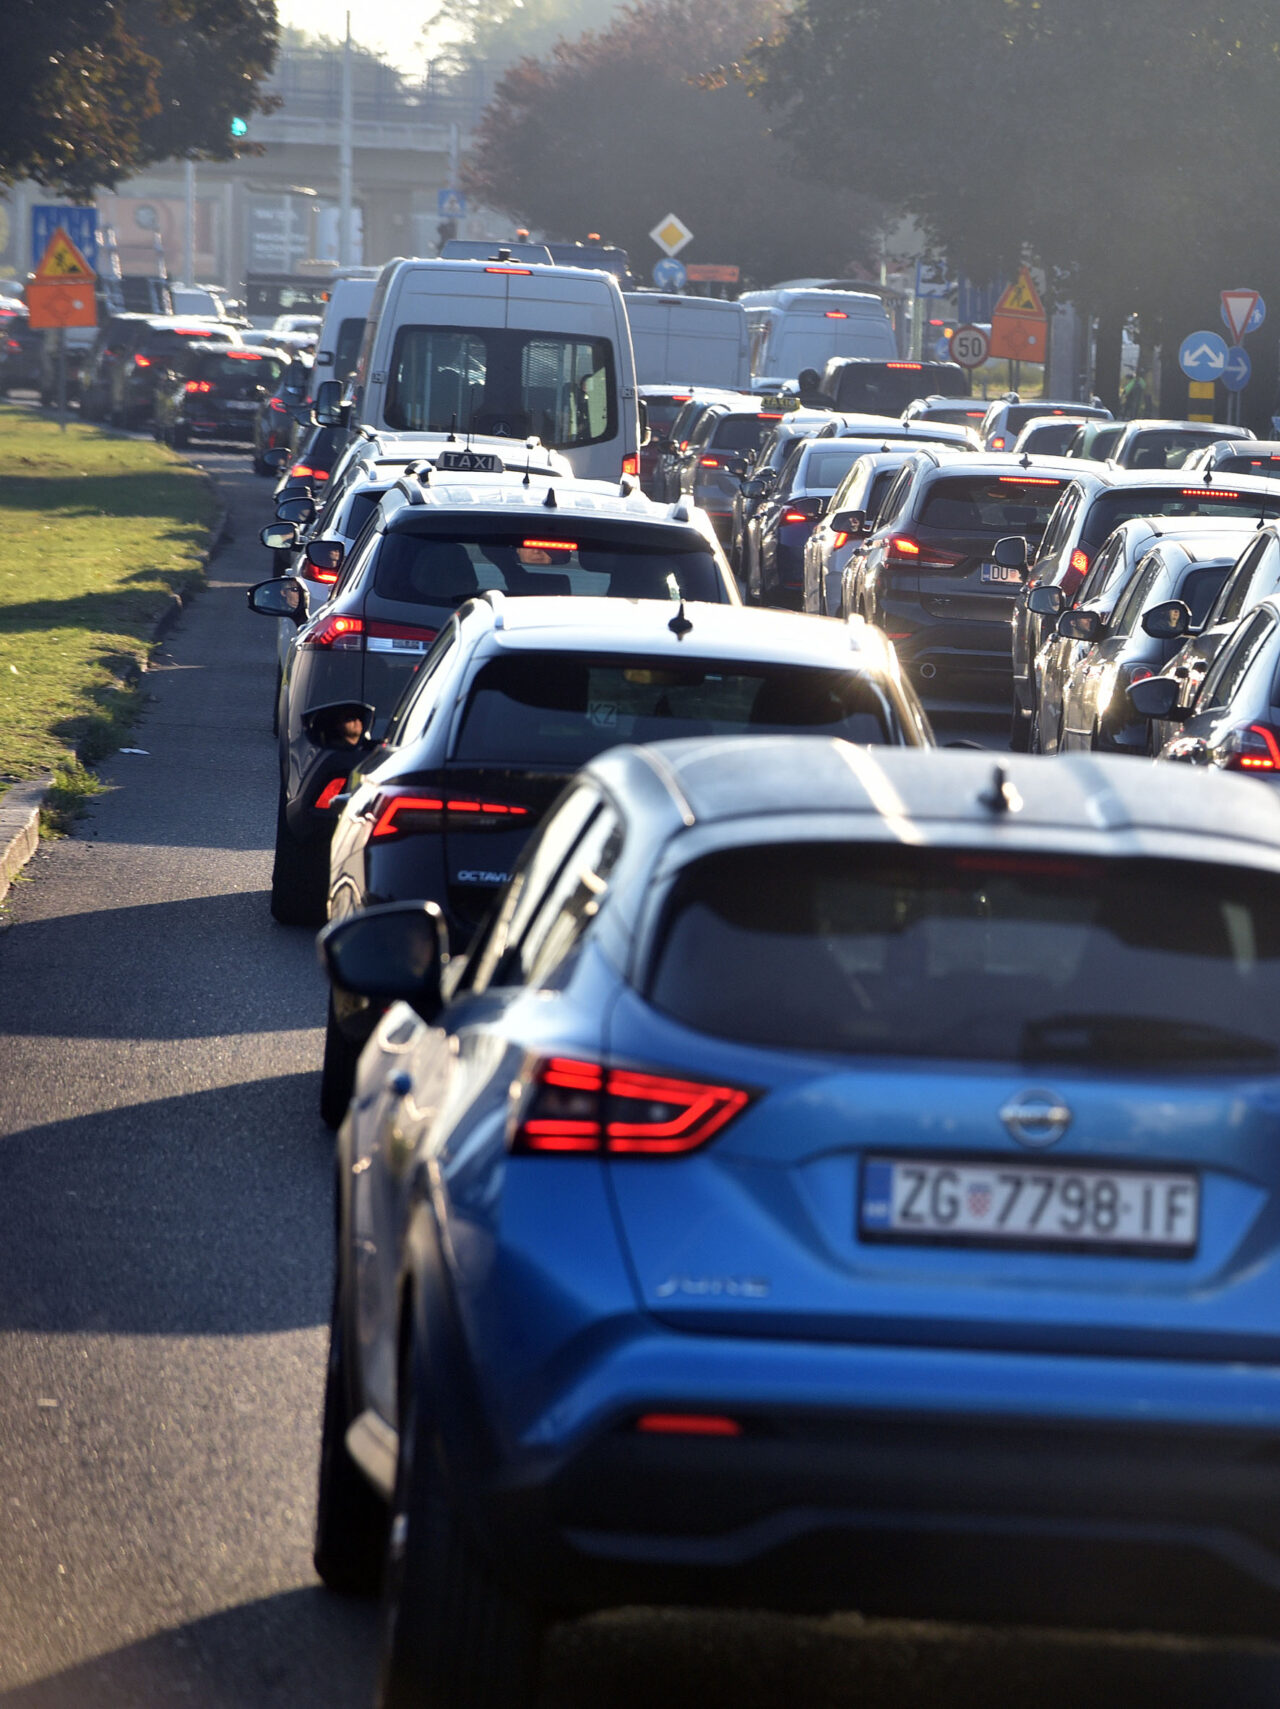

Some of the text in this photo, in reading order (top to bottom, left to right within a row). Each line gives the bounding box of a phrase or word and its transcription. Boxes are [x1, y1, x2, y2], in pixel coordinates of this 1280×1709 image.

[958, 337, 982, 357] 50
[446, 453, 493, 470] TAXI
[991, 565, 1008, 580] DU
[900, 1168, 961, 1226] ZG
